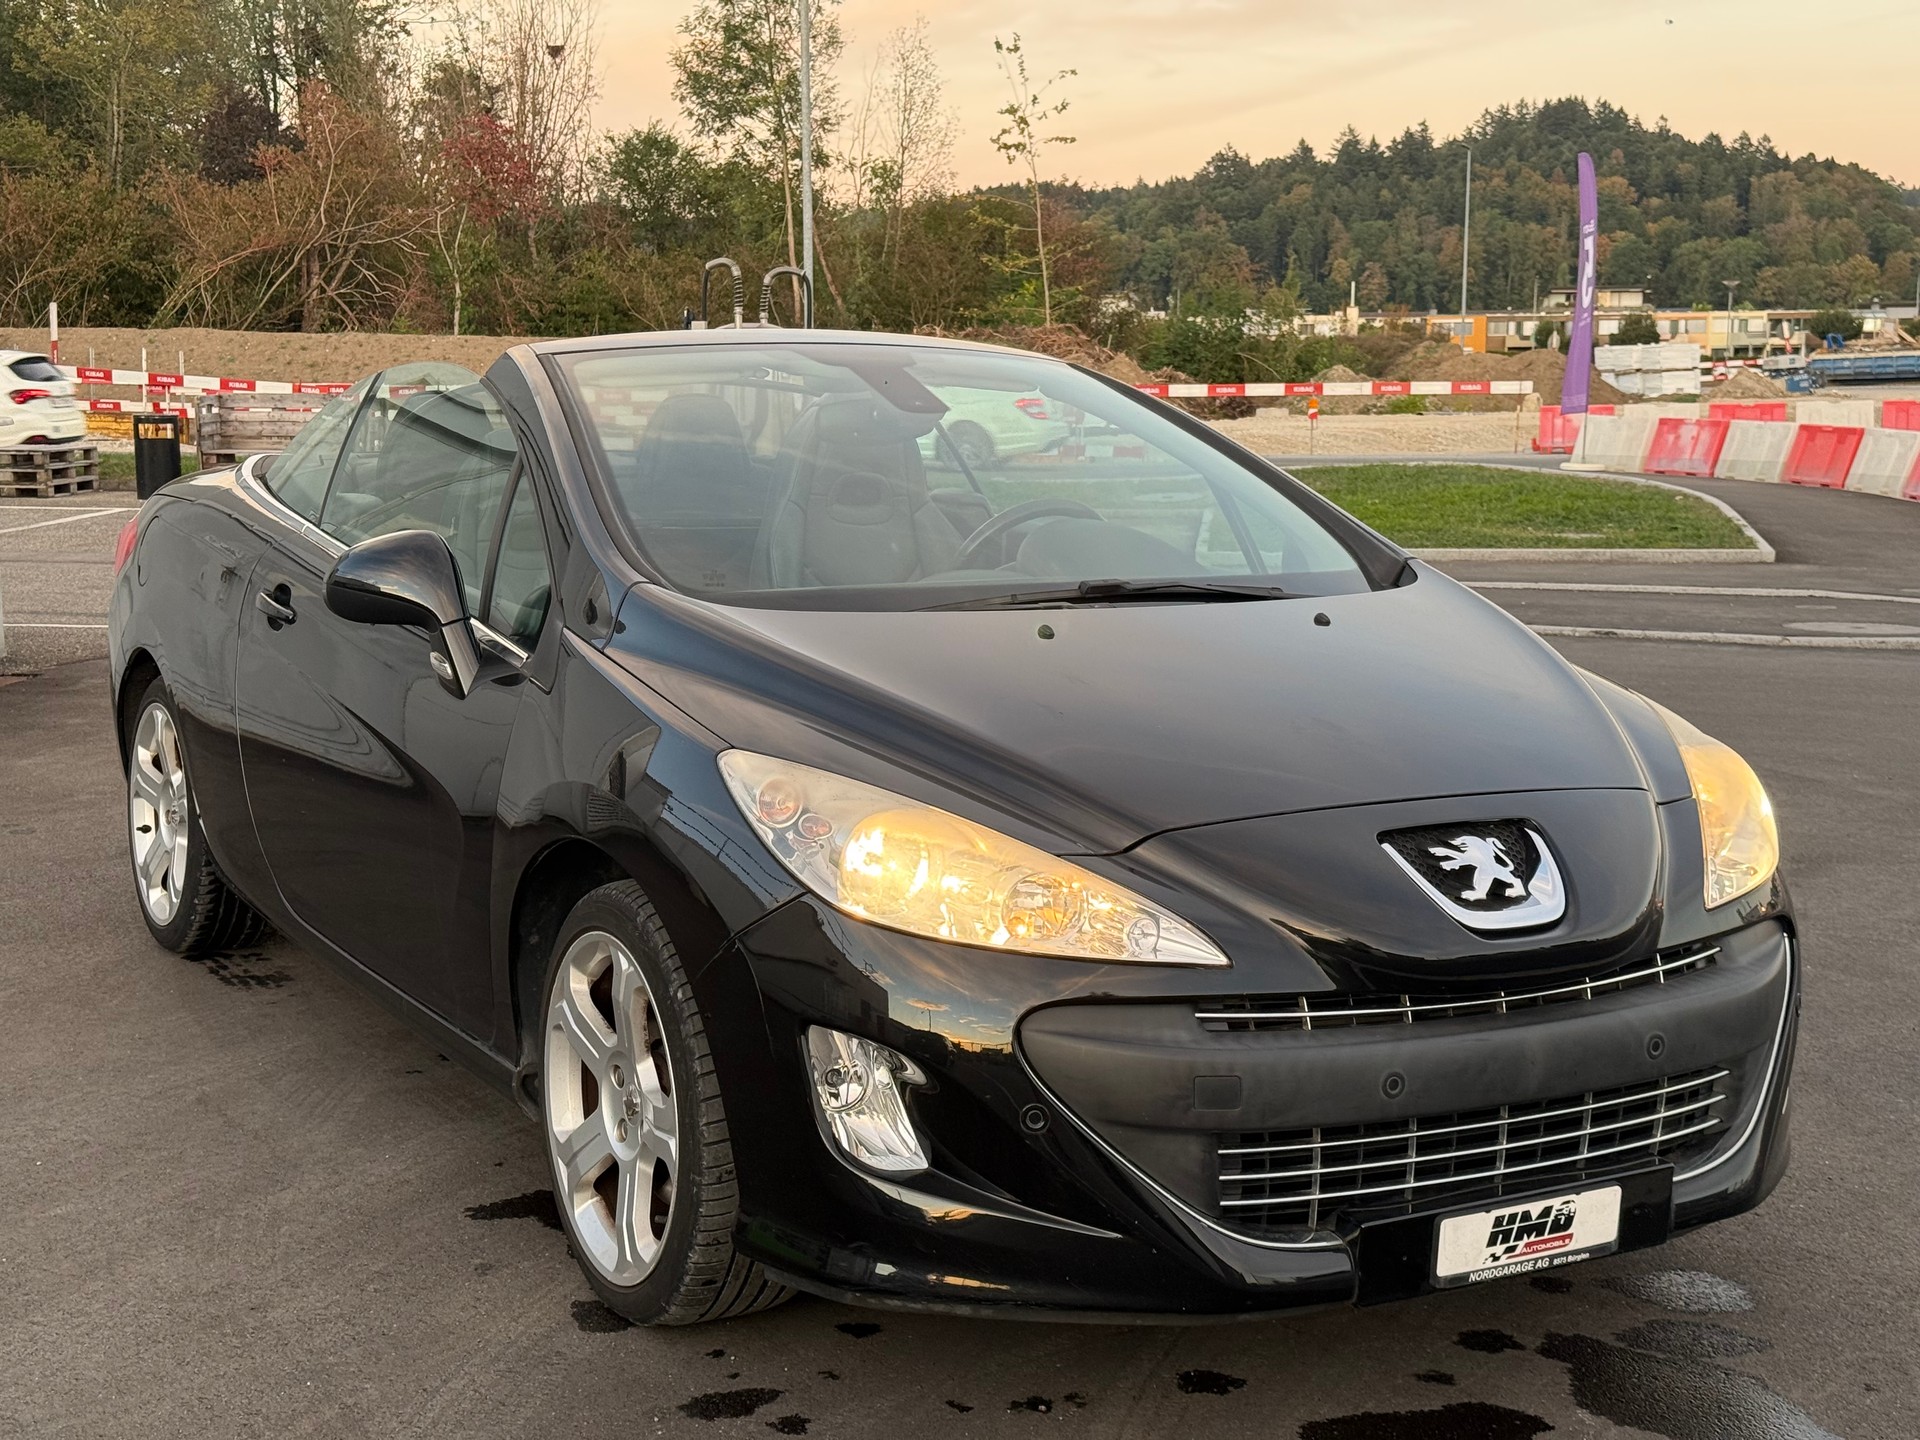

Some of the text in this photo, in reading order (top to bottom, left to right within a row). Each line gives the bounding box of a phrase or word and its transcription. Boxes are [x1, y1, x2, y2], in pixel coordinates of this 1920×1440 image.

[228, 381, 248, 389] KIBAG
[1521, 1238, 1571, 1254] AUTOMOBILE
[1468, 1260, 1536, 1282] NORDGARAGE
[1535, 1258, 1550, 1270] AG
